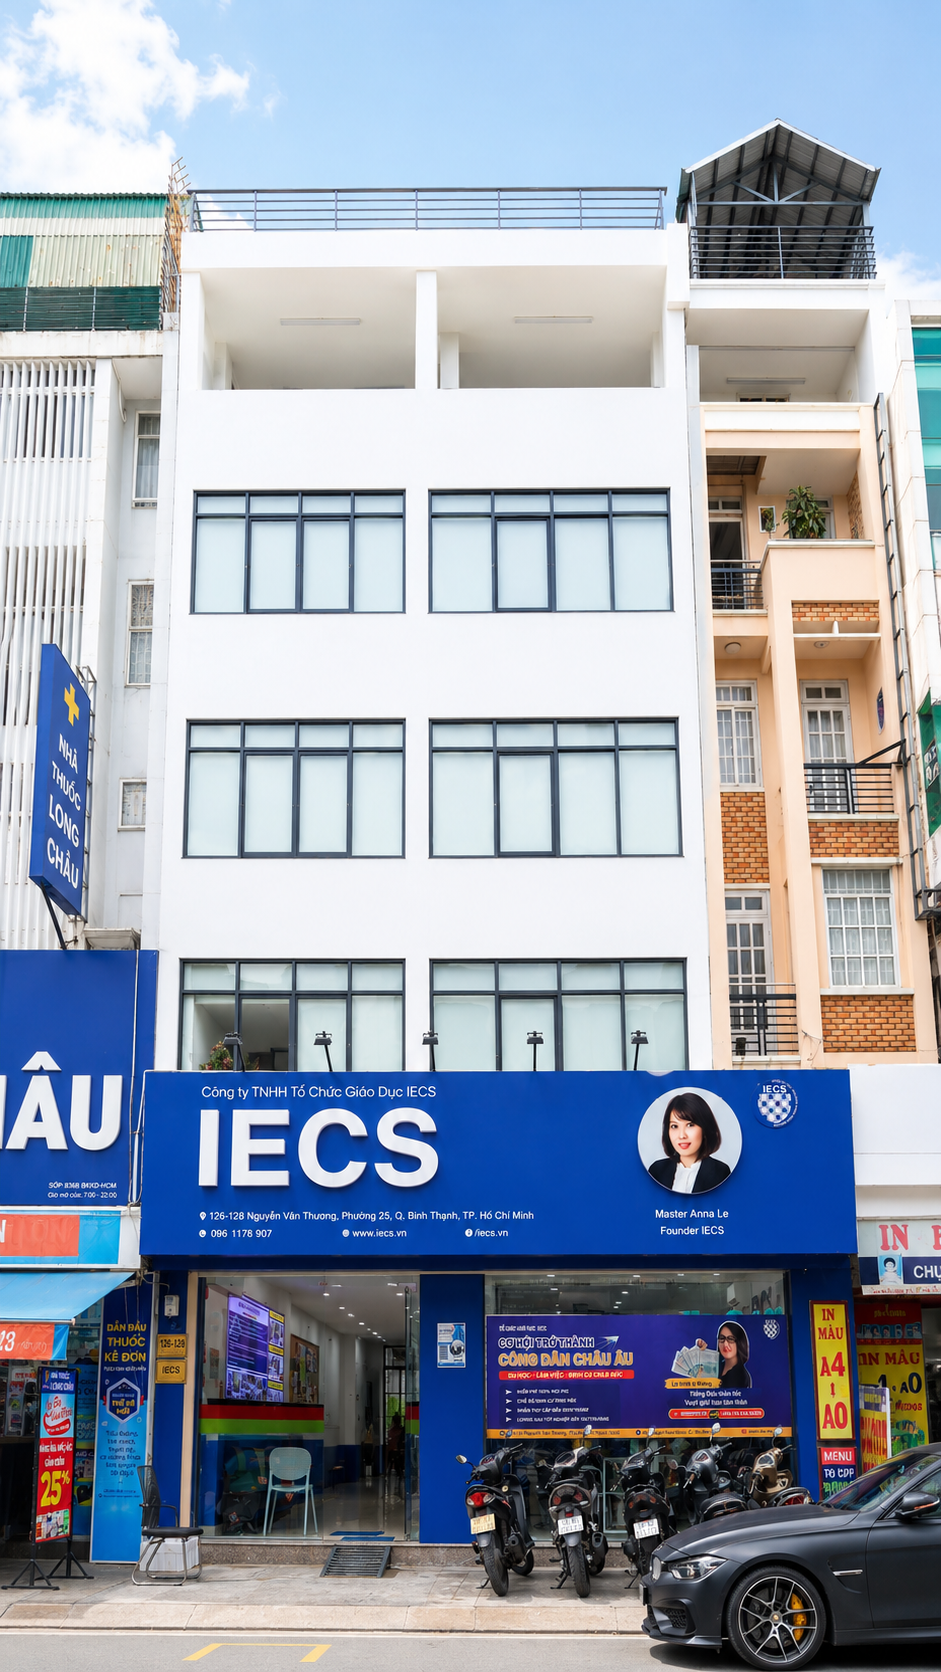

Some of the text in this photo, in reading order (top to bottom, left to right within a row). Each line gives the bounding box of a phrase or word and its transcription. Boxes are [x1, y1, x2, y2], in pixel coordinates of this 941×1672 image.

[59, 733, 78, 774] NHÀ
[49, 794, 79, 848] LONG
[238, 1087, 249, 1100] ty
[252, 1086, 287, 1097] TNHH
[345, 1085, 374, 1098] Giáo
[378, 1086, 403, 1100] Dục
[407, 1086, 436, 1097] IECS
[764, 1085, 787, 1093] IECS
[0, 1051, 123, 1151] ÂU
[199, 1107, 439, 1188] IECS
[209, 1211, 244, 1220] 126-128
[379, 1211, 392, 1221] 25,
[395, 1211, 405, 1221] Q.
[430, 1211, 460, 1222] Thạnh,
[463, 1211, 477, 1220] TP.
[513, 1211, 534, 1220] Minh
[655, 1208, 729, 1219] Master Anna Le
[255, 1229, 272, 1238] 907
[352, 1229, 407, 1238] www.iecs.vn
[660, 1226, 724, 1236] Founder IECS
[879, 1224, 909, 1251] IN
[822, 1308, 835, 1321] IN
[498, 1349, 633, 1367] CÔNG DÂN CHÂU ÂU
[820, 1351, 845, 1377] A4
[162, 1365, 180, 1374] IECS
[823, 1451, 852, 1462] MENU
